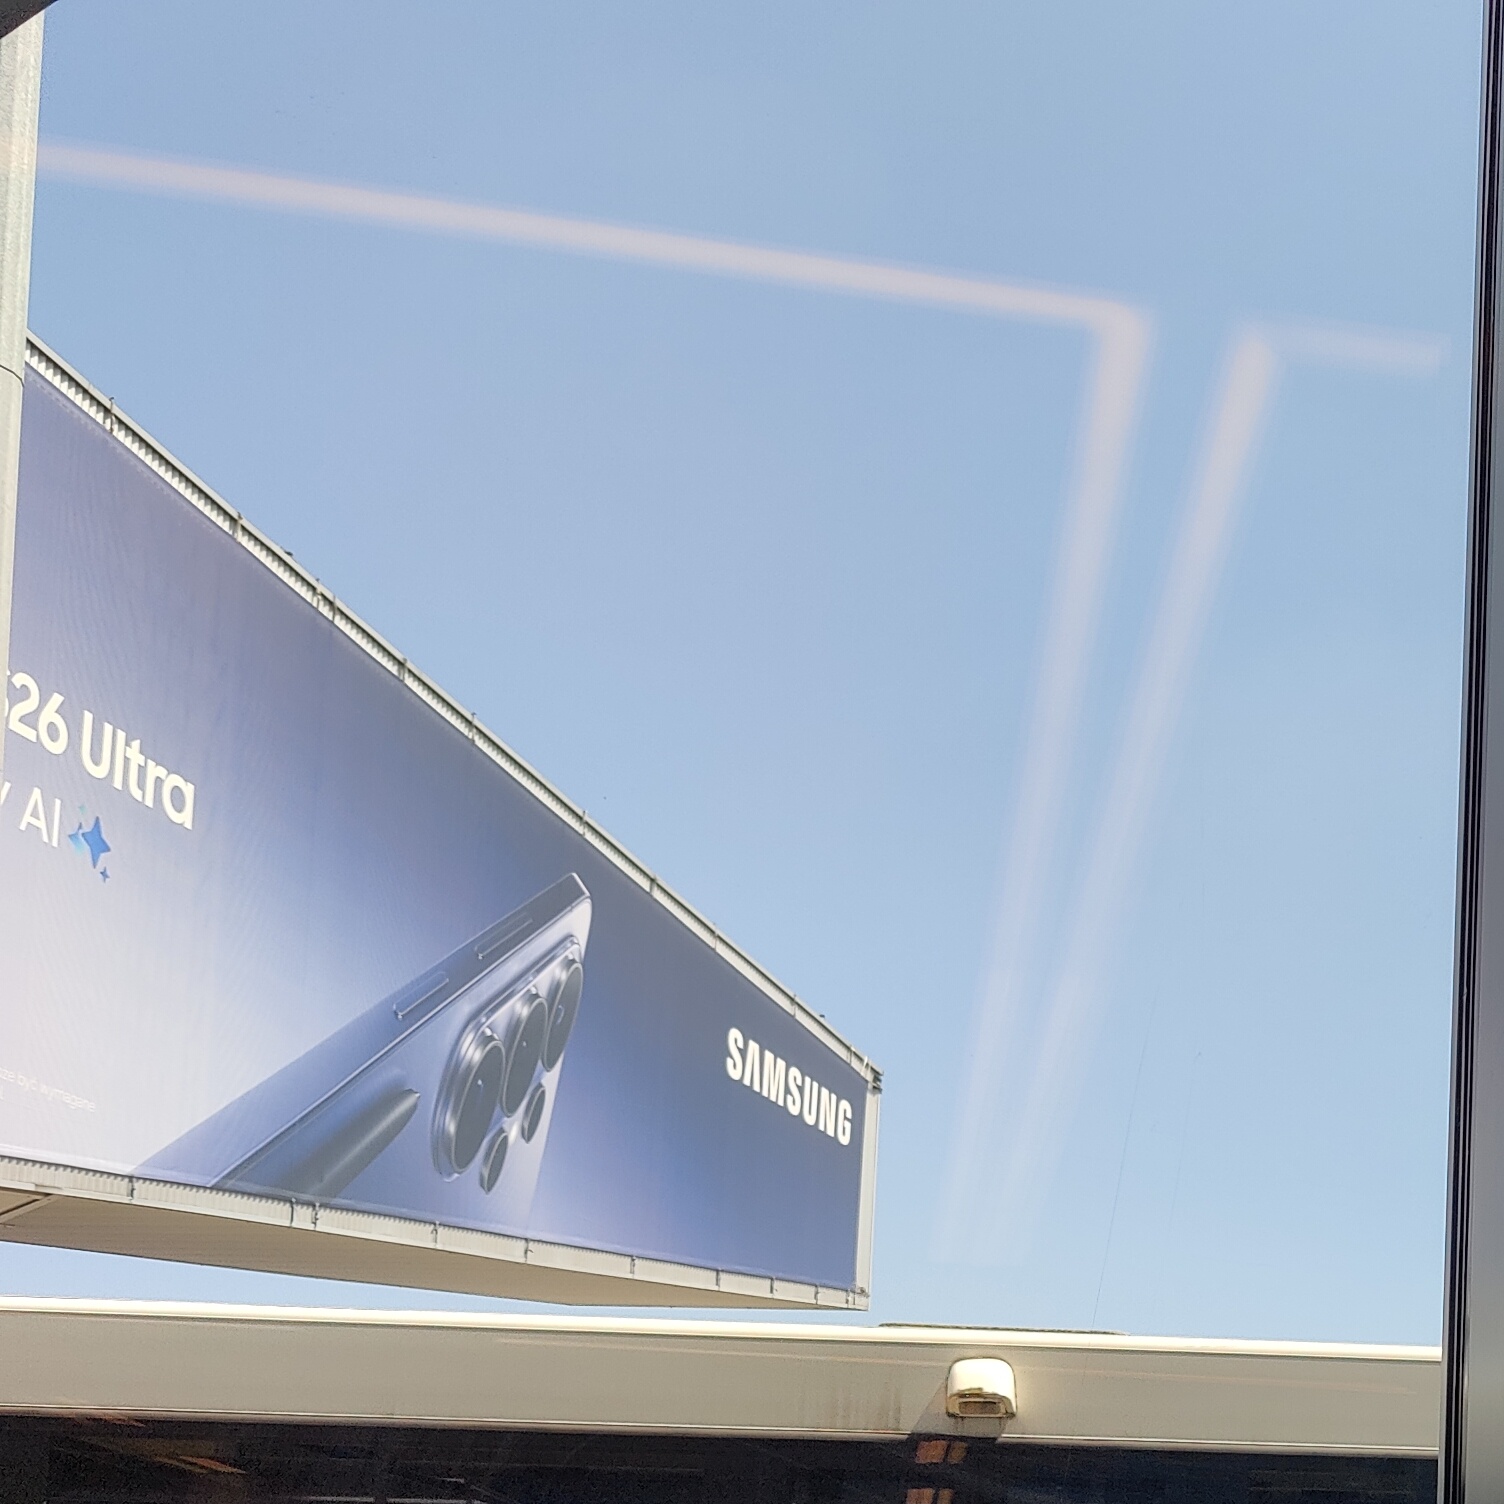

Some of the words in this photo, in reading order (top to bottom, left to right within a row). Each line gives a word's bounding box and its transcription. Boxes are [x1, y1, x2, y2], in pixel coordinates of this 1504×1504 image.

[4, 669, 69, 755] 26
[81, 709, 195, 830] Ultra
[19, 787, 61, 848] AI
[726, 1027, 853, 1146] SAMSUNG
